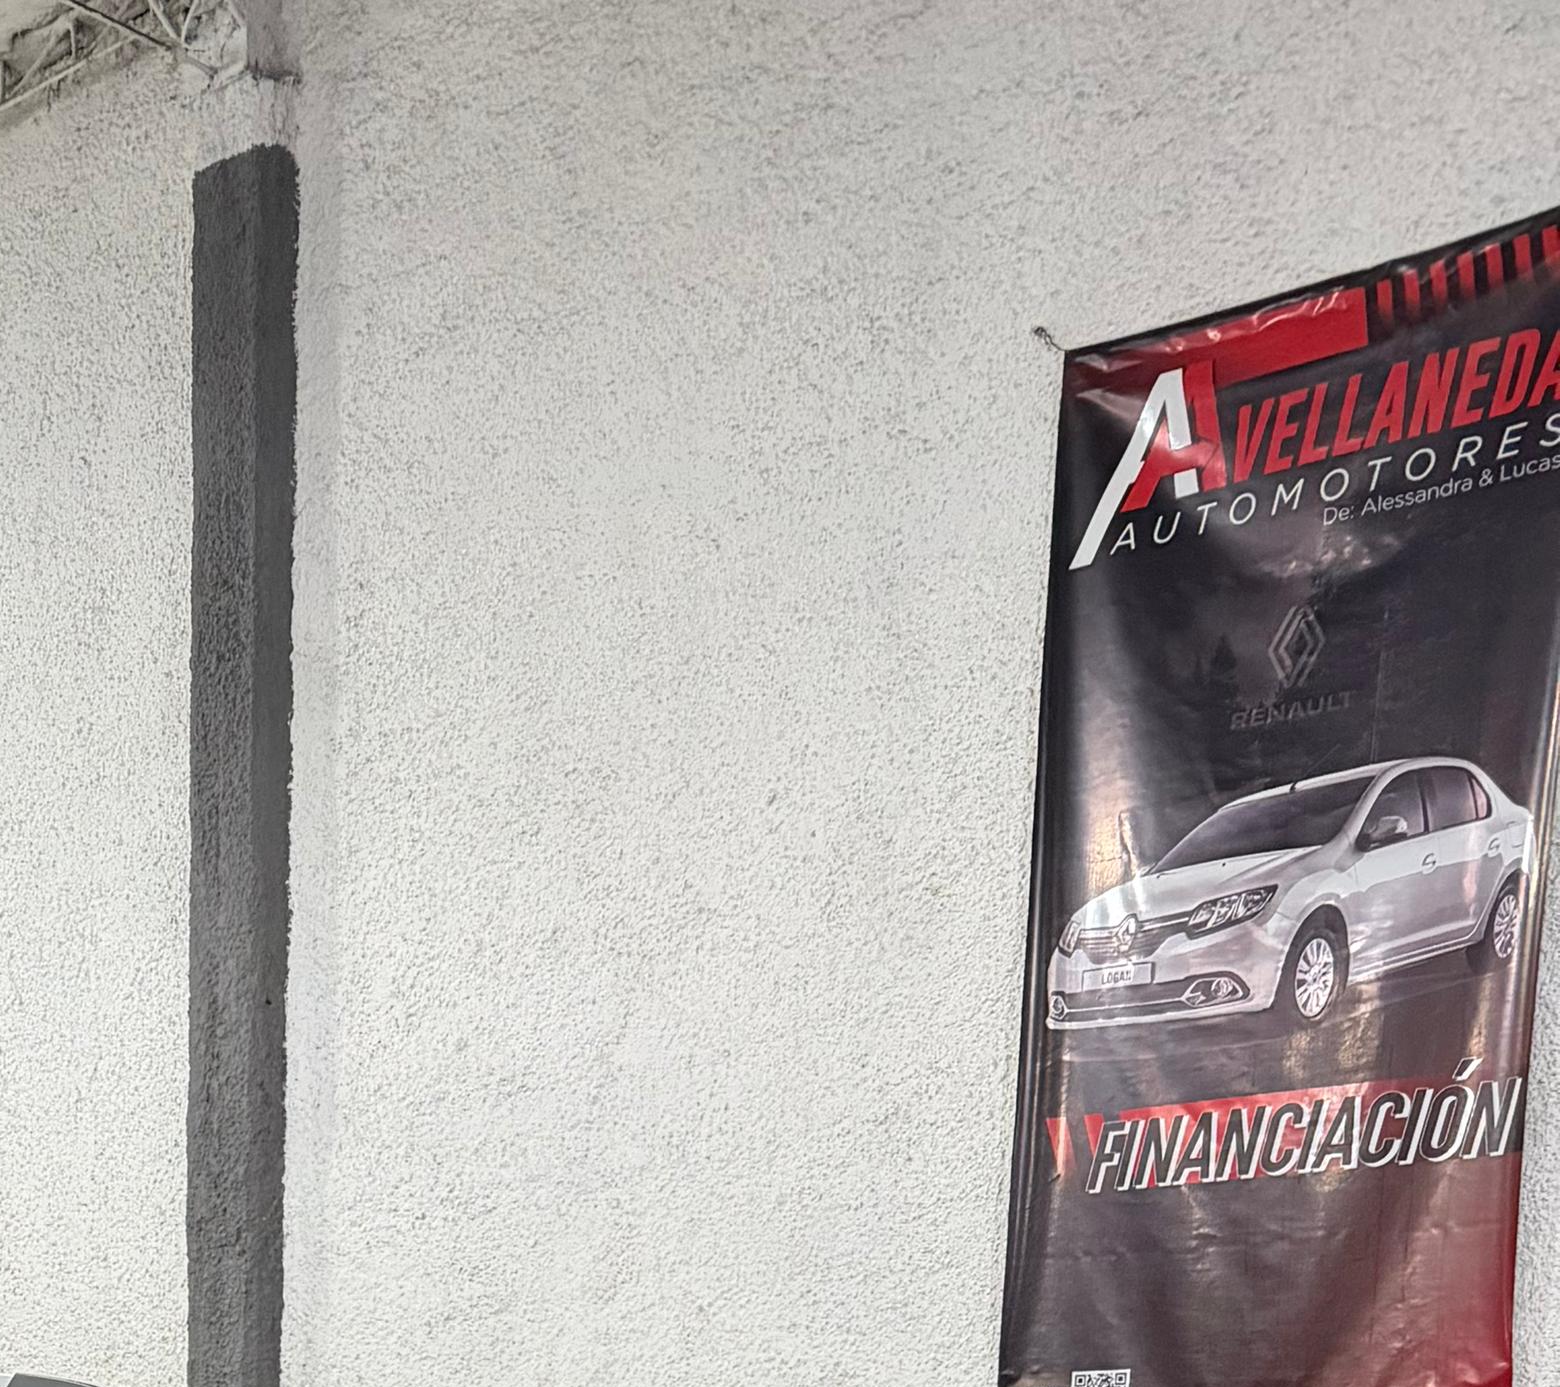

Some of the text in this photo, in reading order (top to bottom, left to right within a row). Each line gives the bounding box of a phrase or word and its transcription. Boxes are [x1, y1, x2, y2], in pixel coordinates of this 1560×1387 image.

[1068, 328, 1560, 571] AVELLANEDA
[1110, 413, 1560, 555] AUTOMOTORES
[1323, 454, 1560, 526] De: Alessandra & Lucas
[1230, 692, 1354, 730] RENAULT
[1085, 1056, 1523, 1194] FINANCIACIÓN
